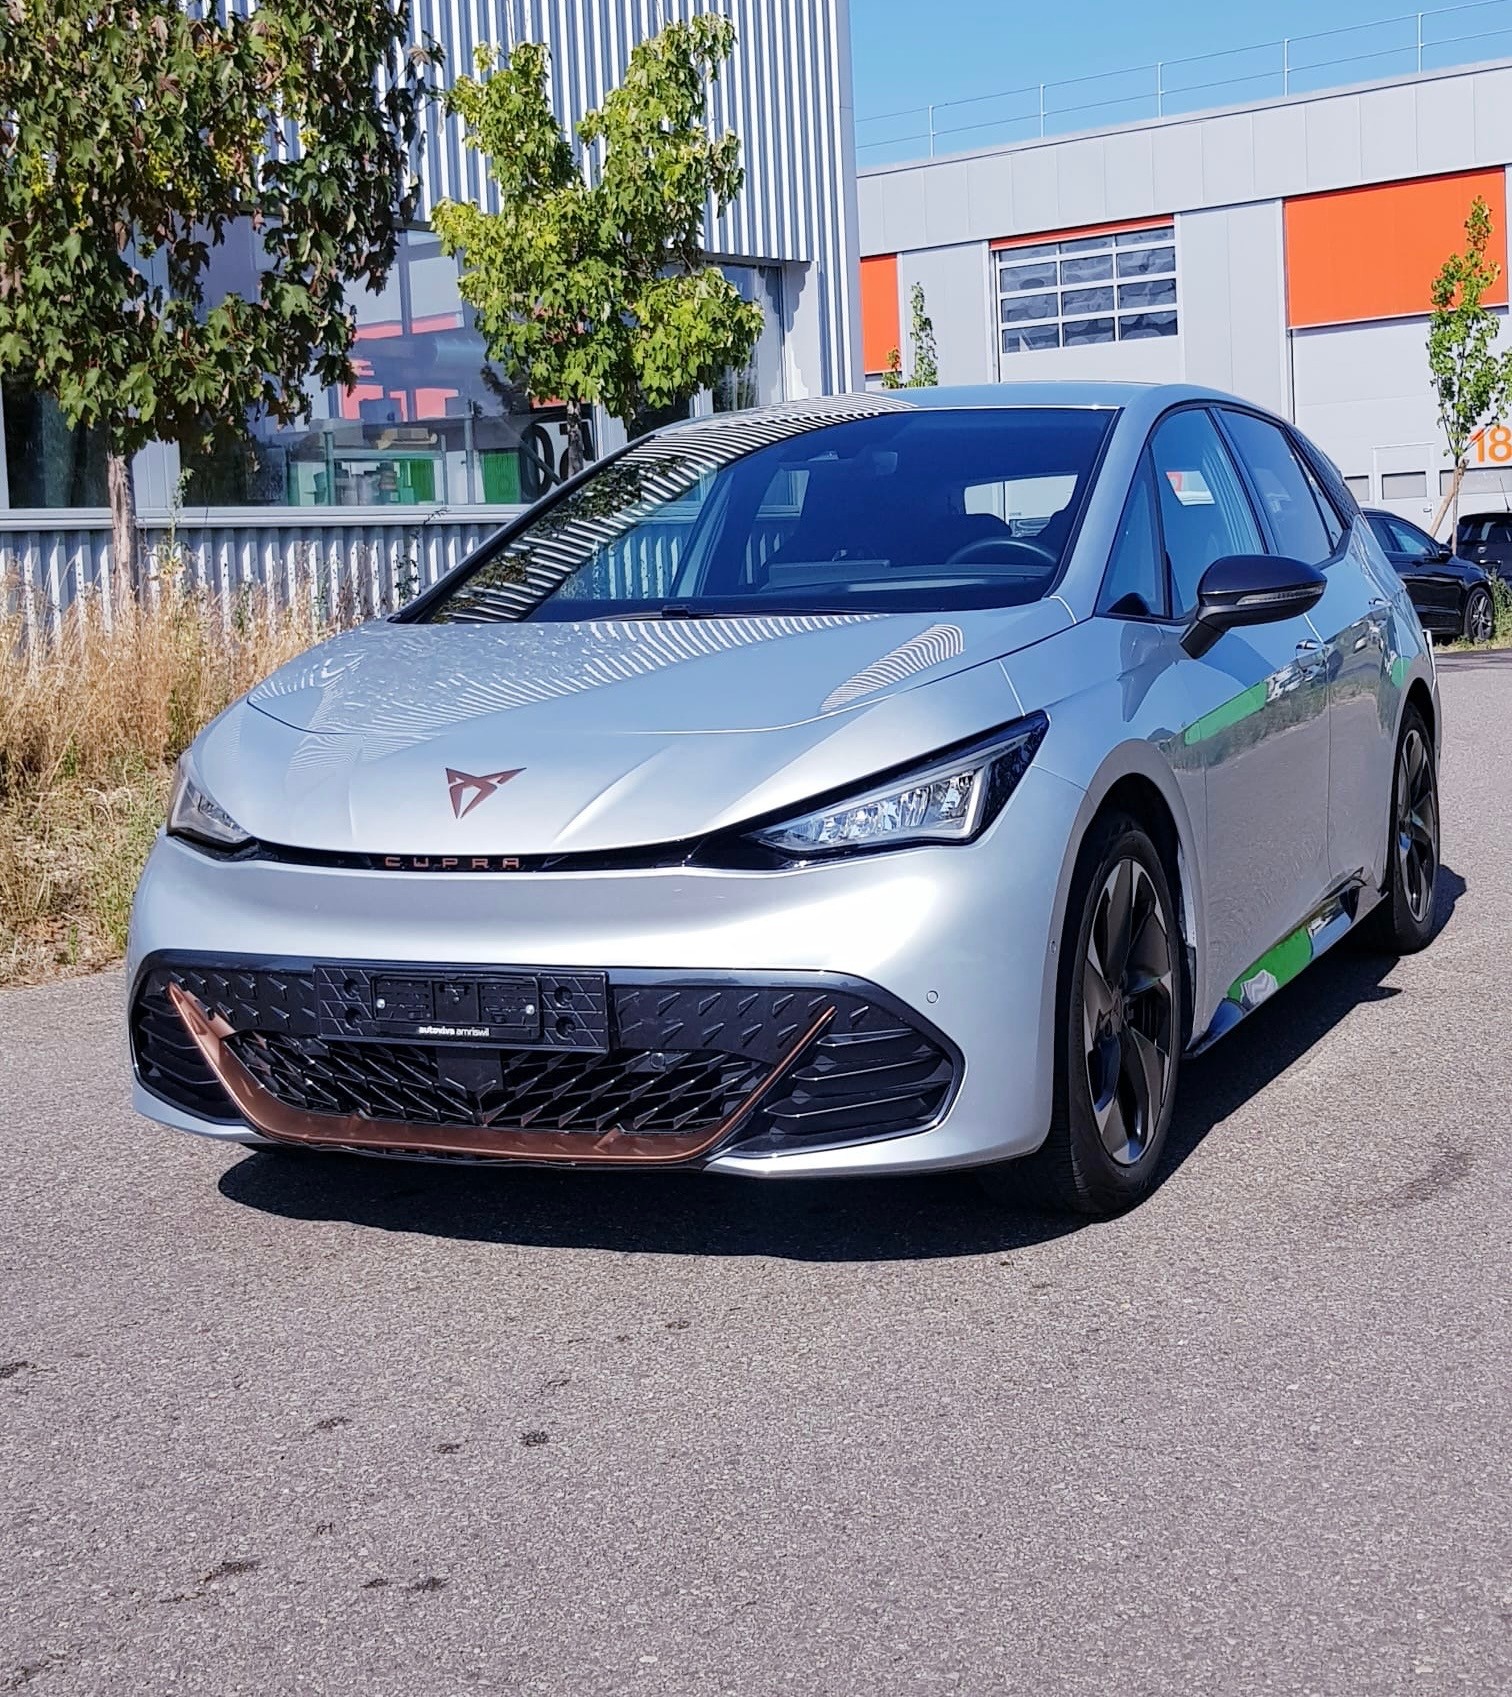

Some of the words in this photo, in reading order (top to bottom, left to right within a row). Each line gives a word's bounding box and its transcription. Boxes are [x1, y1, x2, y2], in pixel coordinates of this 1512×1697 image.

[1470, 424, 1512, 463] 18
[384, 856, 520, 869] CUPRA
[418, 1025, 455, 1035] autoviva
[456, 1027, 490, 1037] amriswil
